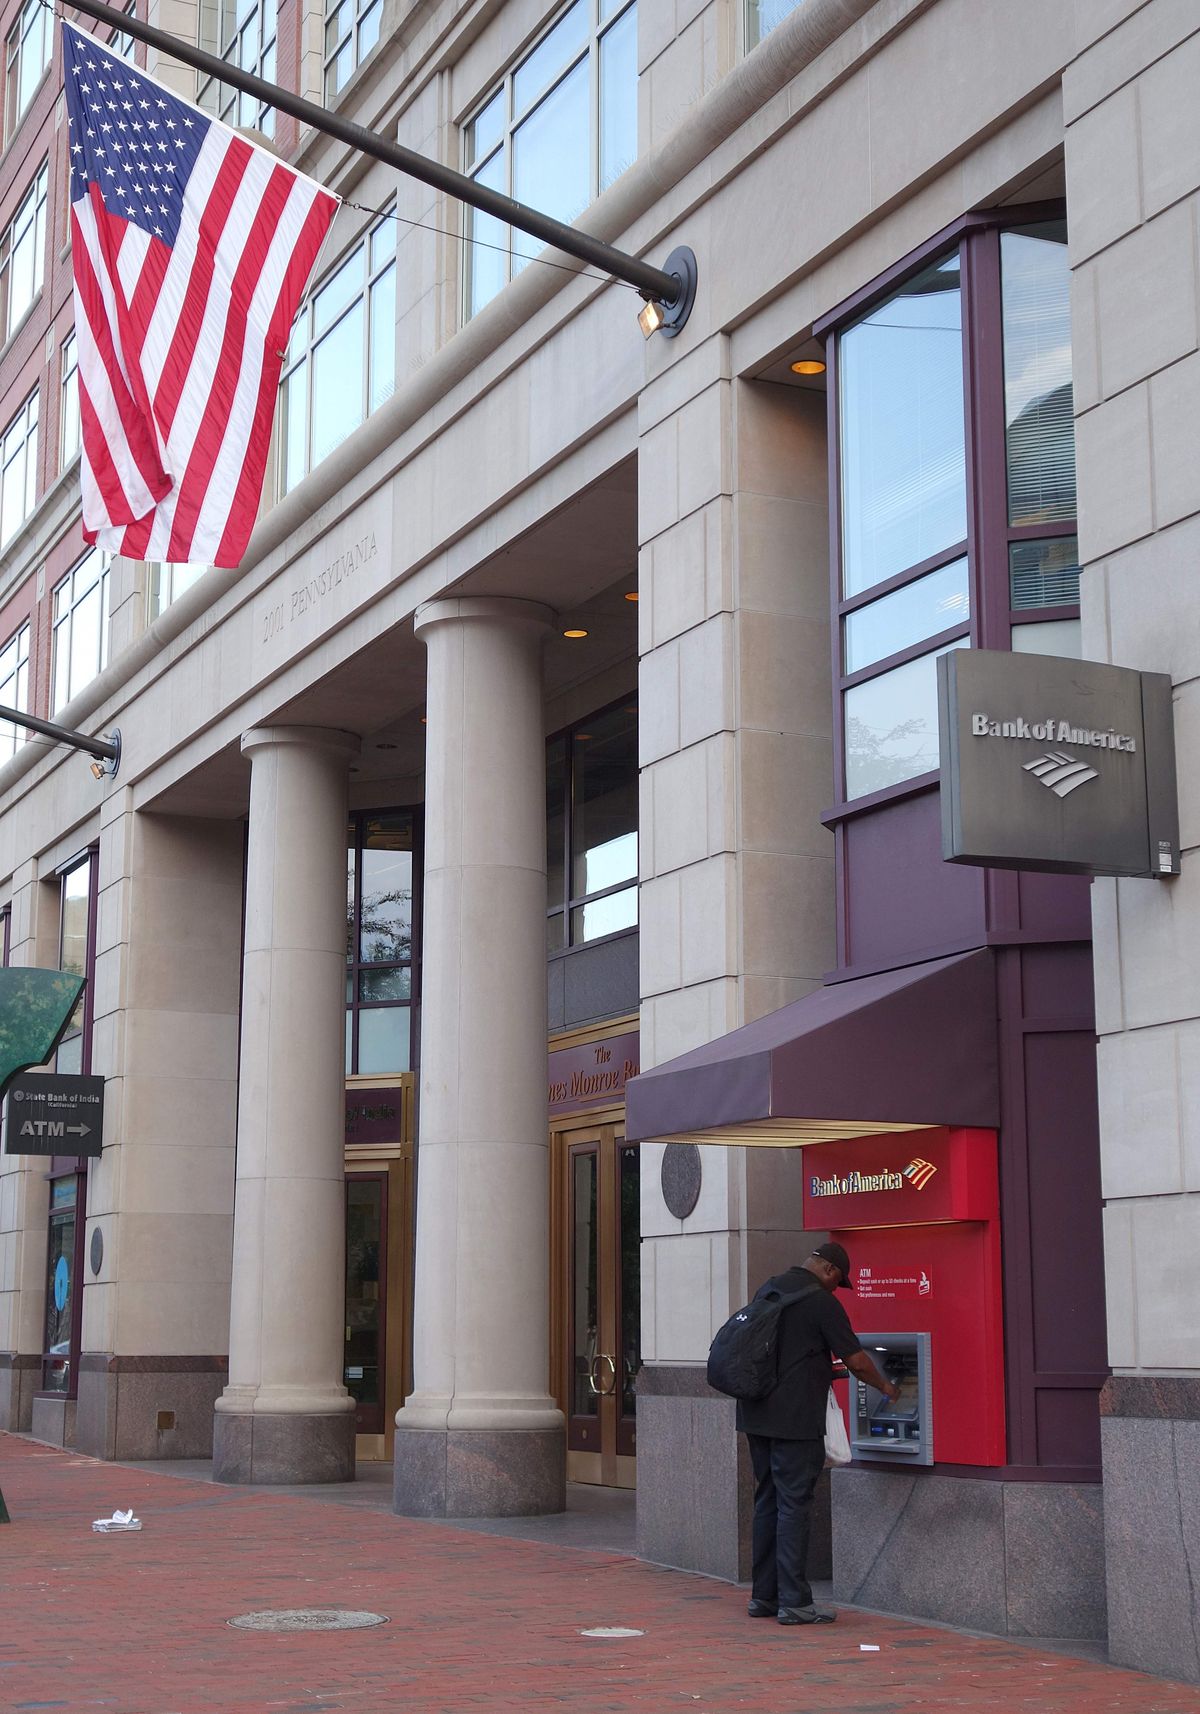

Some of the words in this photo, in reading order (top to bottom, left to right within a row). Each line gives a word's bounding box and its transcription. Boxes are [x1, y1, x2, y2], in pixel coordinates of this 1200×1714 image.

[262, 602, 284, 644] 2001
[289, 530, 378, 622] PENNSYLVANIA
[971, 712, 1031, 740] Bank
[1032, 718, 1055, 742] of
[1056, 719, 1137, 753] America
[594, 1046, 612, 1065] The
[570, 1068, 620, 1097] Monroe
[25, 1091, 46, 1102] State
[47, 1092, 68, 1103] Bank
[69, 1093, 79, 1103] of
[80, 1094, 100, 1104] India
[20, 1120, 64, 1137] ATM
[811, 1174, 841, 1197] Bank
[841, 1171, 854, 1195] of
[853, 1168, 903, 1193] America
[860, 1268, 871, 1278] ATM
